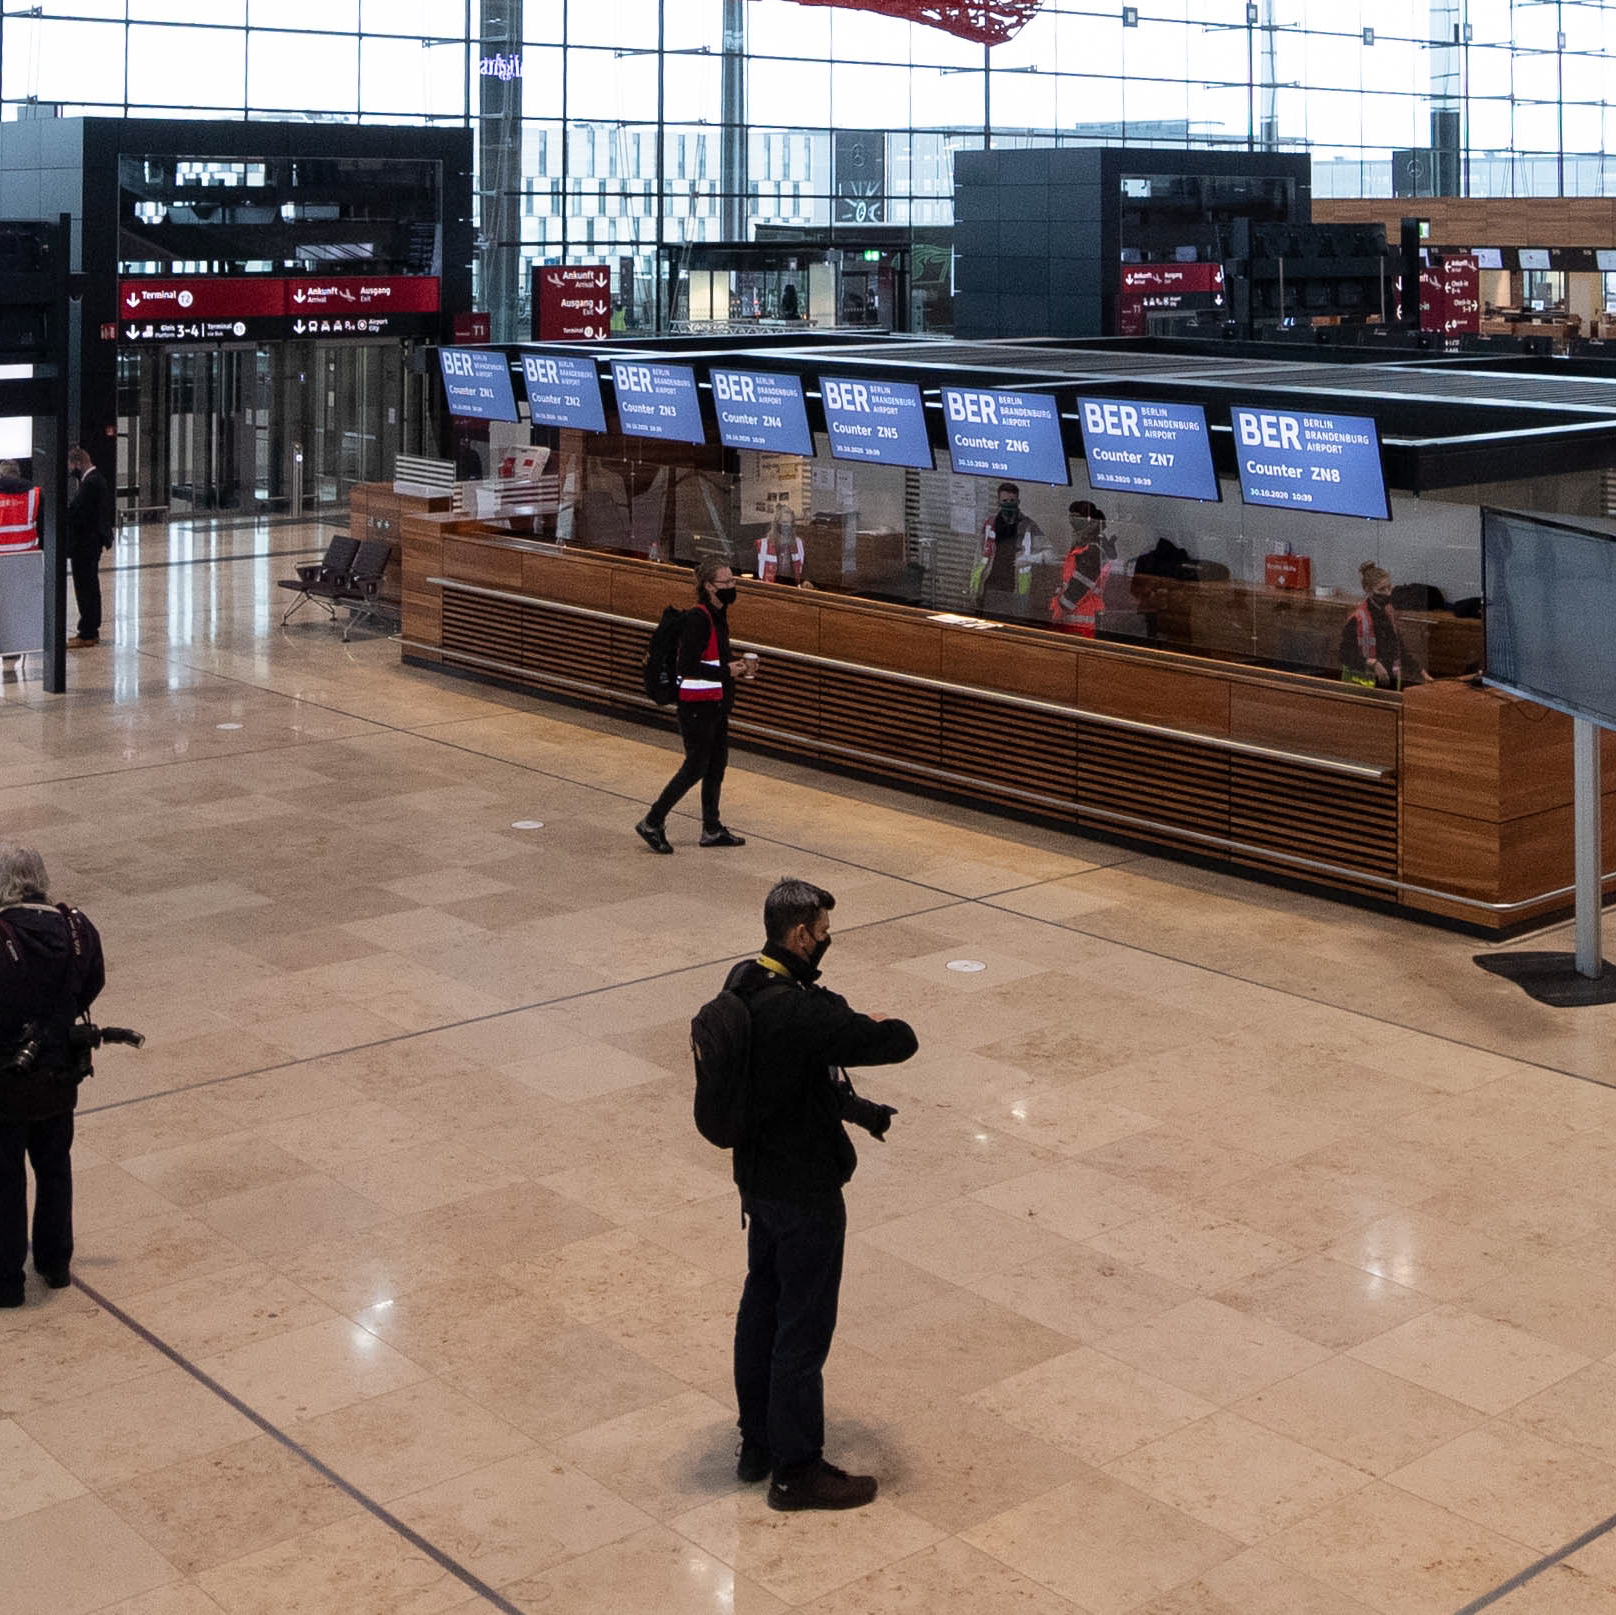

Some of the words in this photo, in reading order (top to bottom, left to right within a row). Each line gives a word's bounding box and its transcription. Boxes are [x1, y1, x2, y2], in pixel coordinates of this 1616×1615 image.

[562, 270, 595, 280] Ankunft
[141, 290, 177, 299] Terminal
[307, 287, 338, 296] Ankunft
[360, 287, 391, 297] Ausgang
[360, 295, 372, 303] Exit
[560, 298, 594, 310] Ausgang
[177, 324, 199, 338] 3-4
[473, 325, 484, 336] T1
[441, 352, 474, 377] BER
[525, 358, 559, 384] BER
[615, 365, 653, 393] BER
[652, 368, 670, 377] BERLIN
[755, 376, 775, 386] BERLIN
[449, 384, 477, 397] Counter
[655, 387, 677, 396] AIRPORT
[714, 373, 757, 403] BER
[757, 386, 798, 398] BRANDENBURG
[869, 385, 891, 395] BERLIN
[531, 392, 561, 405] Counter
[564, 395, 581, 408] ZN2
[758, 396, 783, 406] AIRPORT
[825, 382, 871, 414] BER
[871, 395, 917, 408] BRANDENBURG
[998, 395, 1023, 406] BERLIN
[622, 401, 655, 416] Counter
[659, 405, 677, 417] ZN3
[873, 405, 899, 416] AIRPORT
[947, 391, 999, 425] BER
[999, 406, 1052, 420] BRANDENBURG
[1141, 406, 1168, 418] BERLIN
[721, 411, 758, 426] Counter
[762, 415, 782, 428] ZN4
[1002, 417, 1031, 429] AIRPORT
[1084, 402, 1141, 438] BER
[1143, 418, 1200, 432] BRANDENBURG
[1303, 417, 1333, 429] BERLIN
[832, 421, 872, 437] Counter
[877, 425, 899, 440] ZN5
[1144, 429, 1177, 441] AIRPORT
[1238, 412, 1303, 451] BER
[955, 433, 1000, 451] Counter
[1005, 438, 1030, 454] ZN6
[1304, 429, 1369, 446] BRANDENBURG
[1306, 442, 1343, 455] AIRPORT
[1092, 447, 1143, 465] Counter
[1149, 452, 1175, 468] ZN7
[1246, 460, 1303, 480] Counter
[1311, 466, 1341, 483] ZN8
[1096, 472, 1131, 484] 30.10.2020
[1133, 476, 1152, 486] 10:39
[1250, 488, 1289, 500] 30.10.2020
[1292, 492, 1313, 503] 10:39
